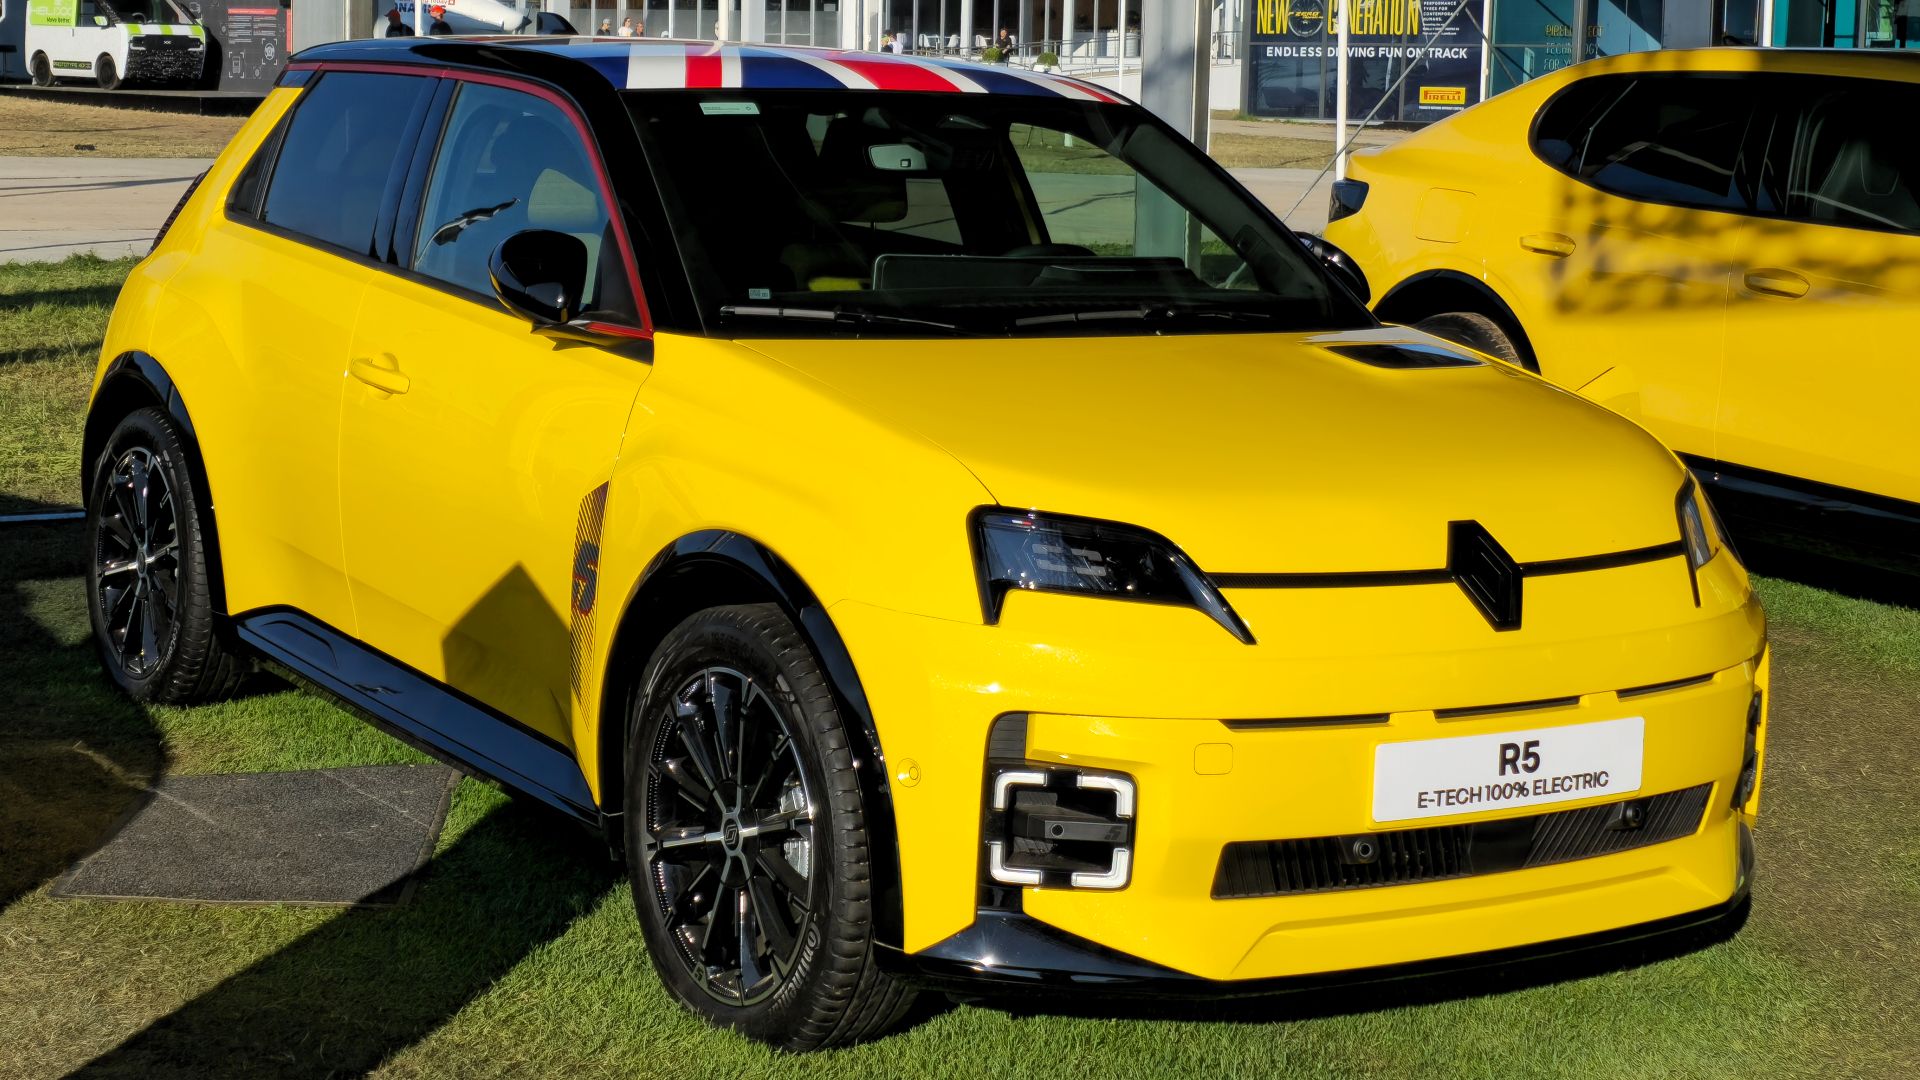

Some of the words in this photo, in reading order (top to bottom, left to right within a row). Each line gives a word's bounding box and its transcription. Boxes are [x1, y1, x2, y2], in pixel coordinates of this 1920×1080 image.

[1256, 0, 1290, 34] NEW
[1327, 0, 1419, 35] GNERATION
[1266, 46, 1323, 57] ENDLESS
[1327, 47, 1375, 58] DVING
[1378, 47, 1402, 58] FUN
[1406, 47, 1424, 58] ON
[1428, 47, 1468, 59] TRACK
[1423, 90, 1462, 101] PIRELLI
[1498, 739, 1541, 777] R5
[1417, 785, 1482, 809] E-TECH
[1485, 781, 1529, 801] 100%
[1532, 770, 1609, 797] ELECTRIC
